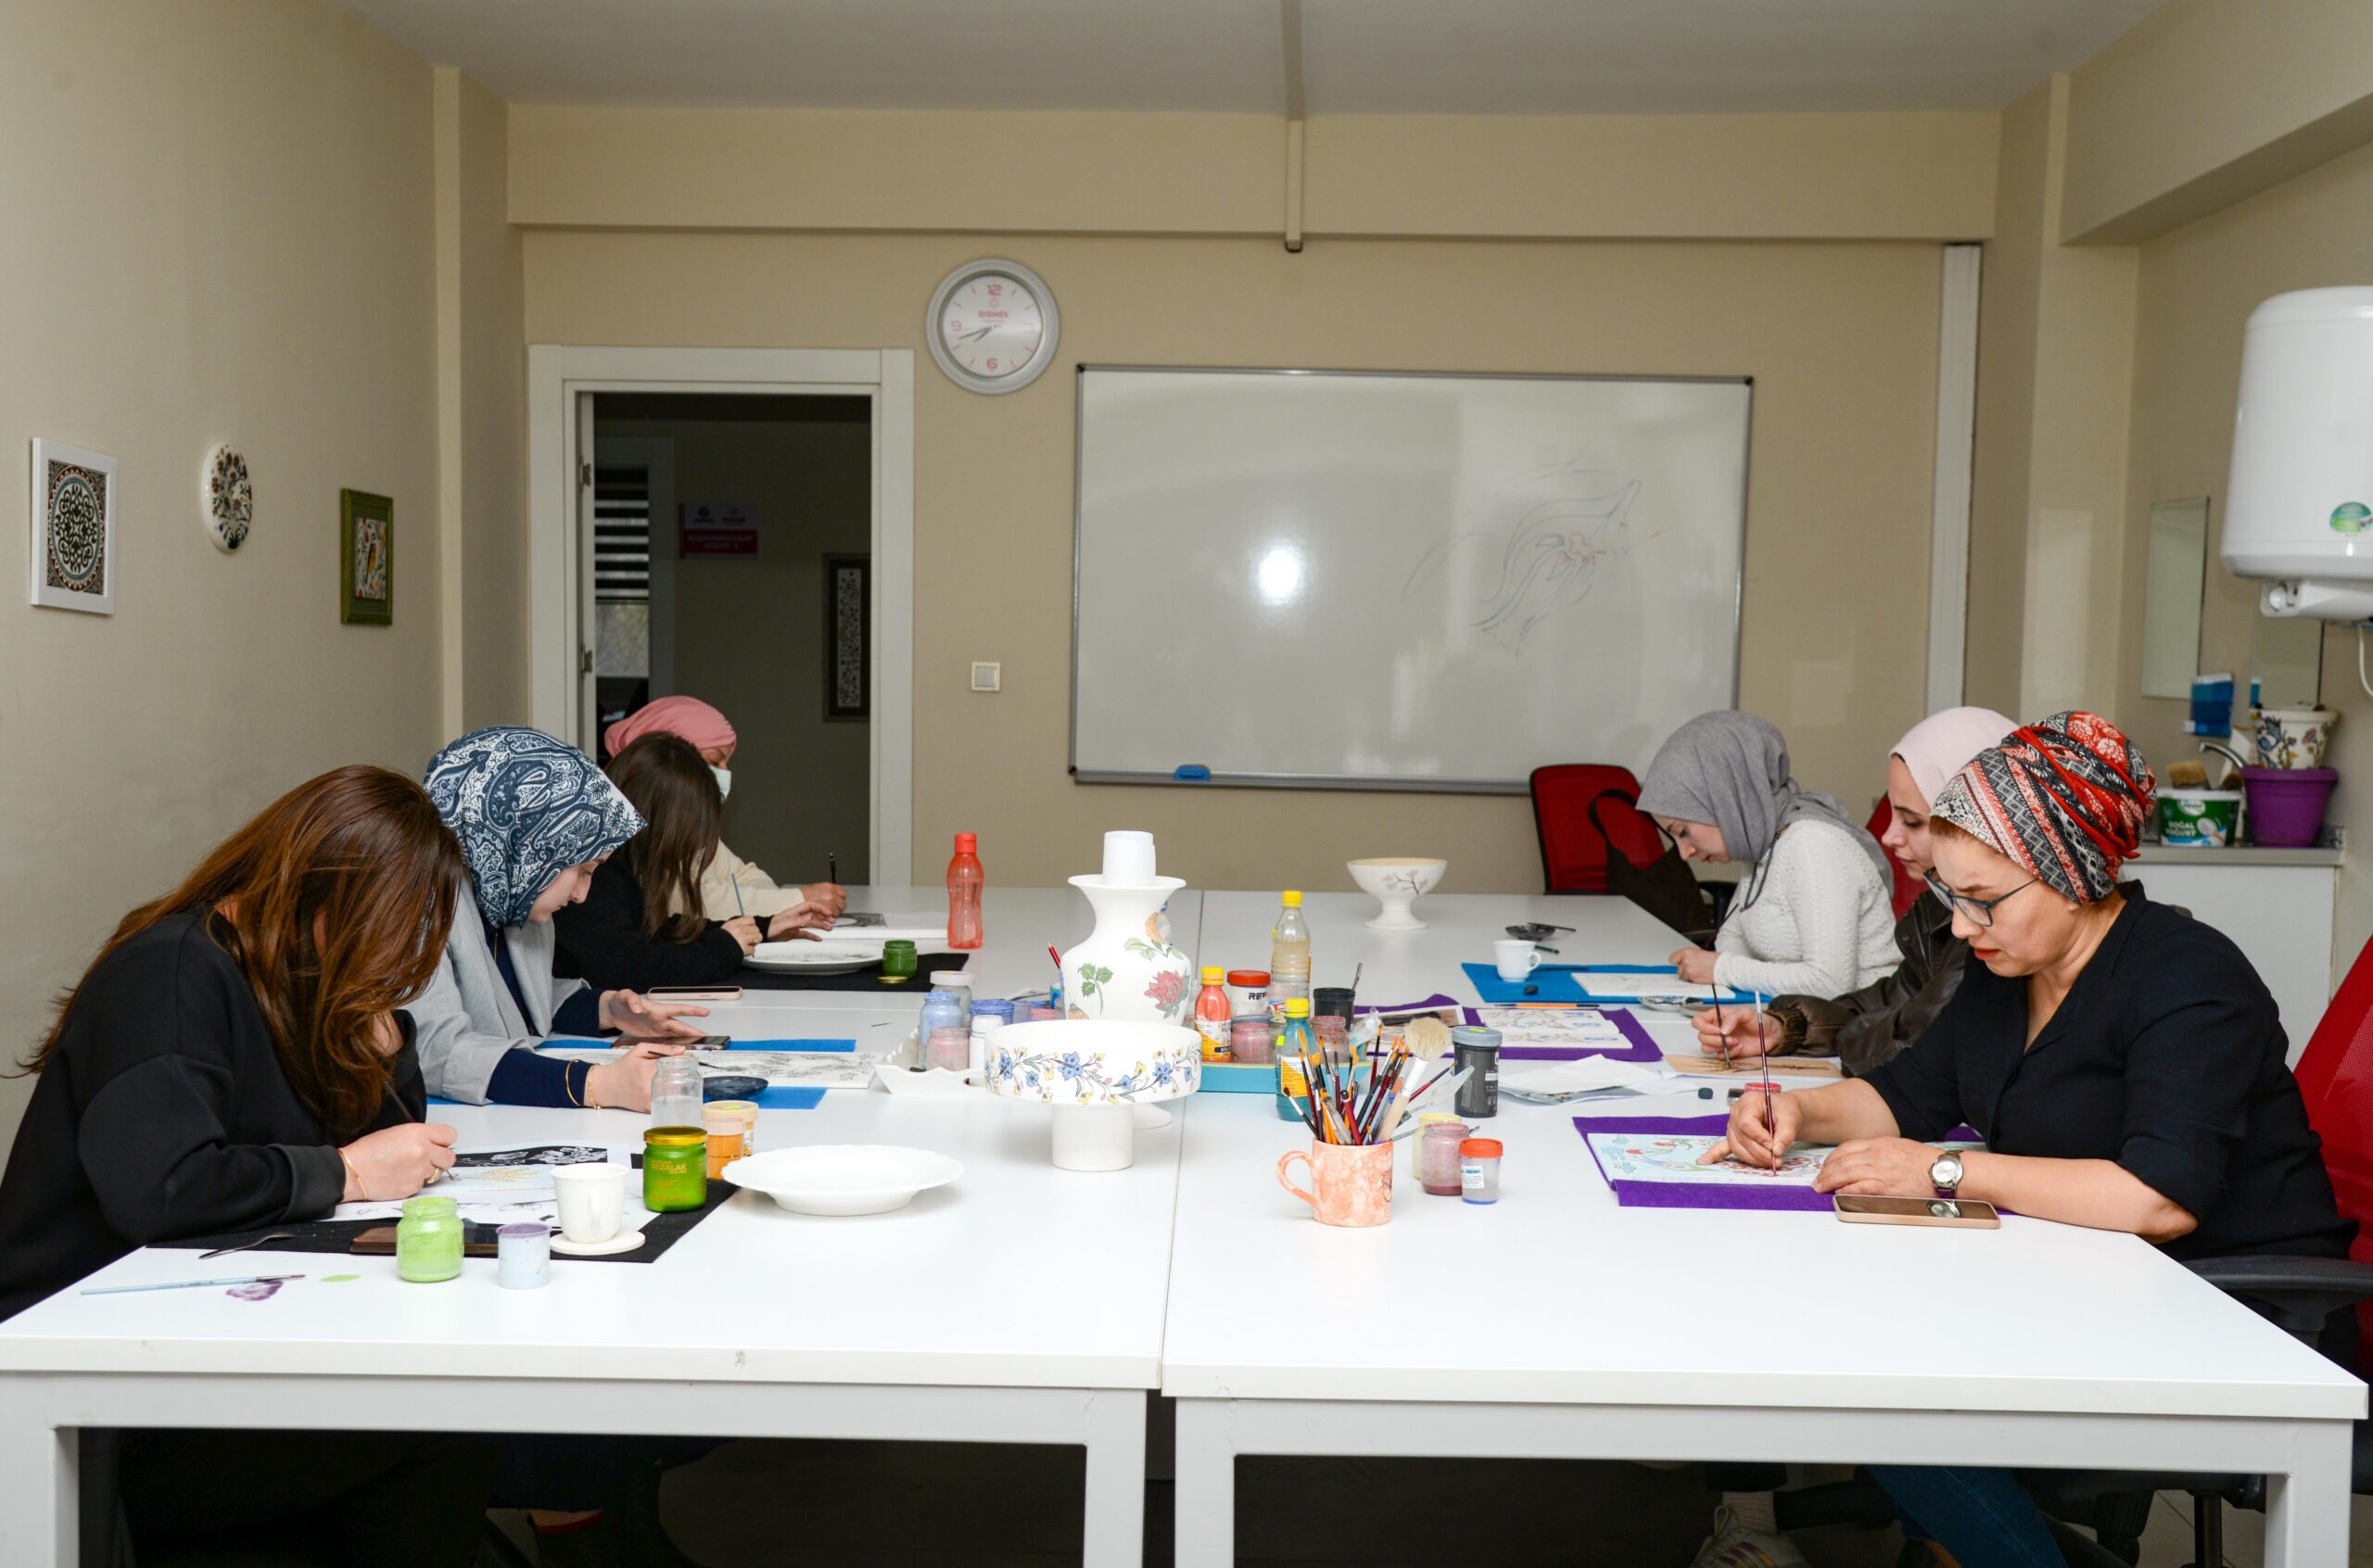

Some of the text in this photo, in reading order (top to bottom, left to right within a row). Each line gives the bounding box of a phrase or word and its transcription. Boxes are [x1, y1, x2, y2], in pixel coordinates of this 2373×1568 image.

[986, 284, 1002, 296] 12
[951, 321, 962, 332] 9
[986, 358, 998, 370] 6
